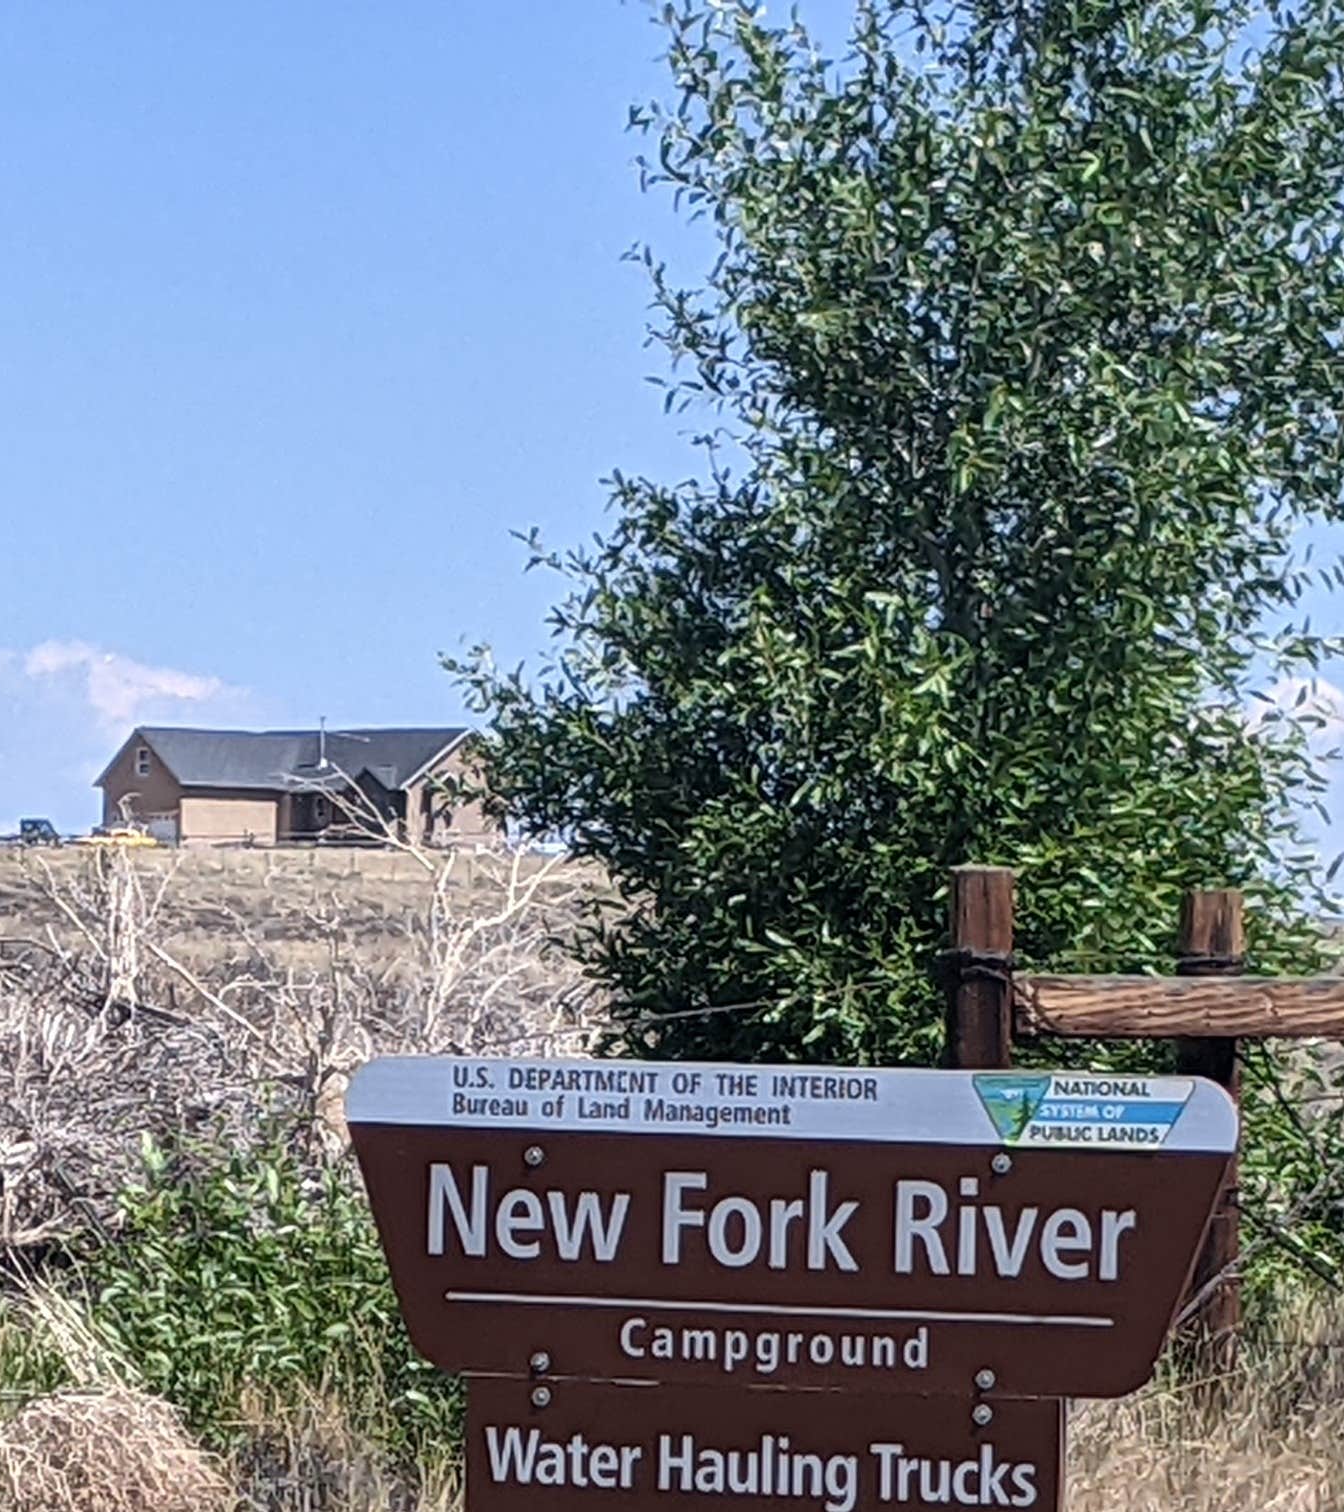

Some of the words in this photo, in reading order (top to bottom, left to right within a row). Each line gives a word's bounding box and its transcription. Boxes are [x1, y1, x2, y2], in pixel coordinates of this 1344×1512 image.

[452, 1065, 495, 1089] U.S.
[508, 1067, 659, 1094] DEPARTMENT
[672, 1072, 702, 1095] OF
[716, 1073, 758, 1097] THE
[772, 1075, 878, 1101] INTERIOR
[1053, 1080, 1151, 1097] NATIONAL
[452, 1092, 529, 1117] Bureau
[541, 1095, 566, 1118] of
[578, 1096, 630, 1119] Land
[644, 1098, 792, 1128] Management
[1038, 1103, 1100, 1119] SYSTEM
[1102, 1104, 1124, 1119] OF
[1028, 1124, 1093, 1142] PUBLIC
[1097, 1125, 1160, 1144] LANDS
[427, 1162, 630, 1262] New
[662, 1170, 860, 1272] Fork
[895, 1176, 1138, 1282] River
[619, 1318, 931, 1375] Campground
[485, 1426, 643, 1489] Water
[870, 1442, 1038, 1508] Trucks
